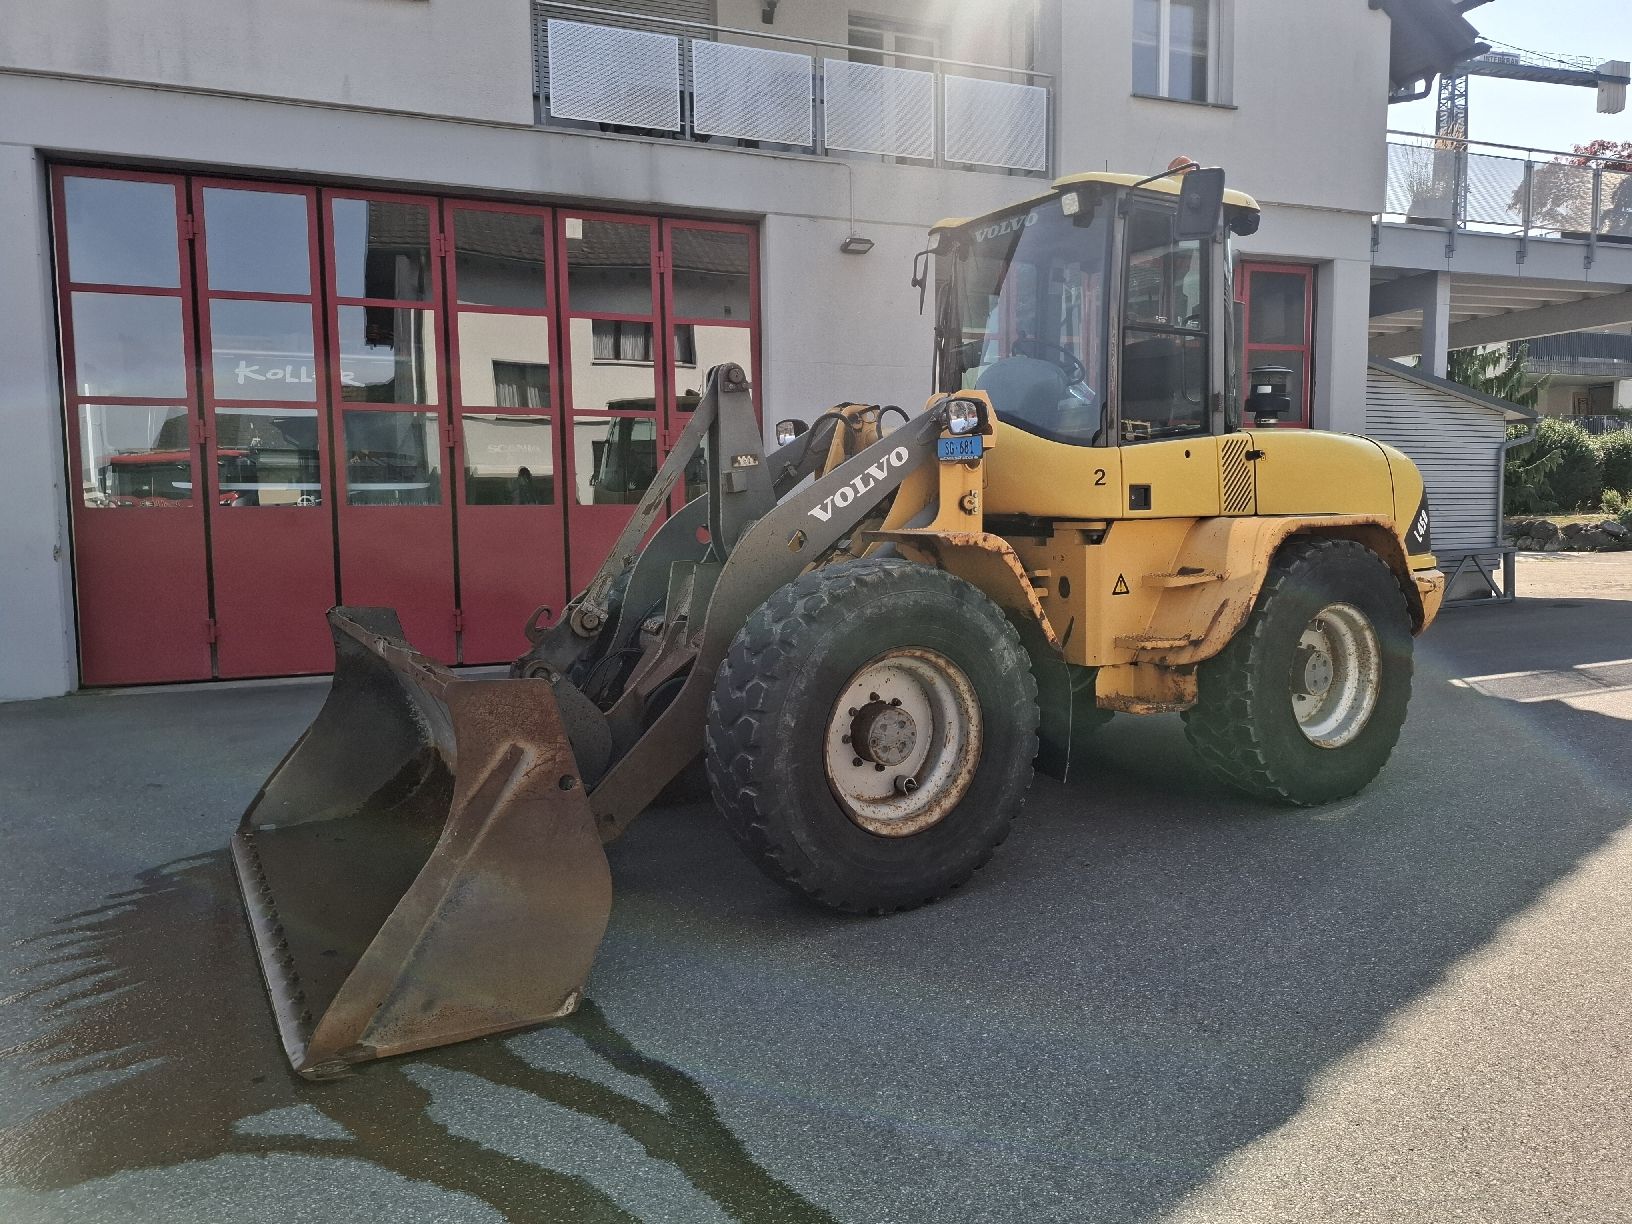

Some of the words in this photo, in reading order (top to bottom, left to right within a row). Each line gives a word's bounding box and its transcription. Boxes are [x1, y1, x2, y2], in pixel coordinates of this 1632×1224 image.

[975, 213, 1038, 242] VOLVO
[234, 361, 365, 387] KOLLR
[808, 446, 909, 522] VOLVO
[1094, 468, 1106, 486] 2
